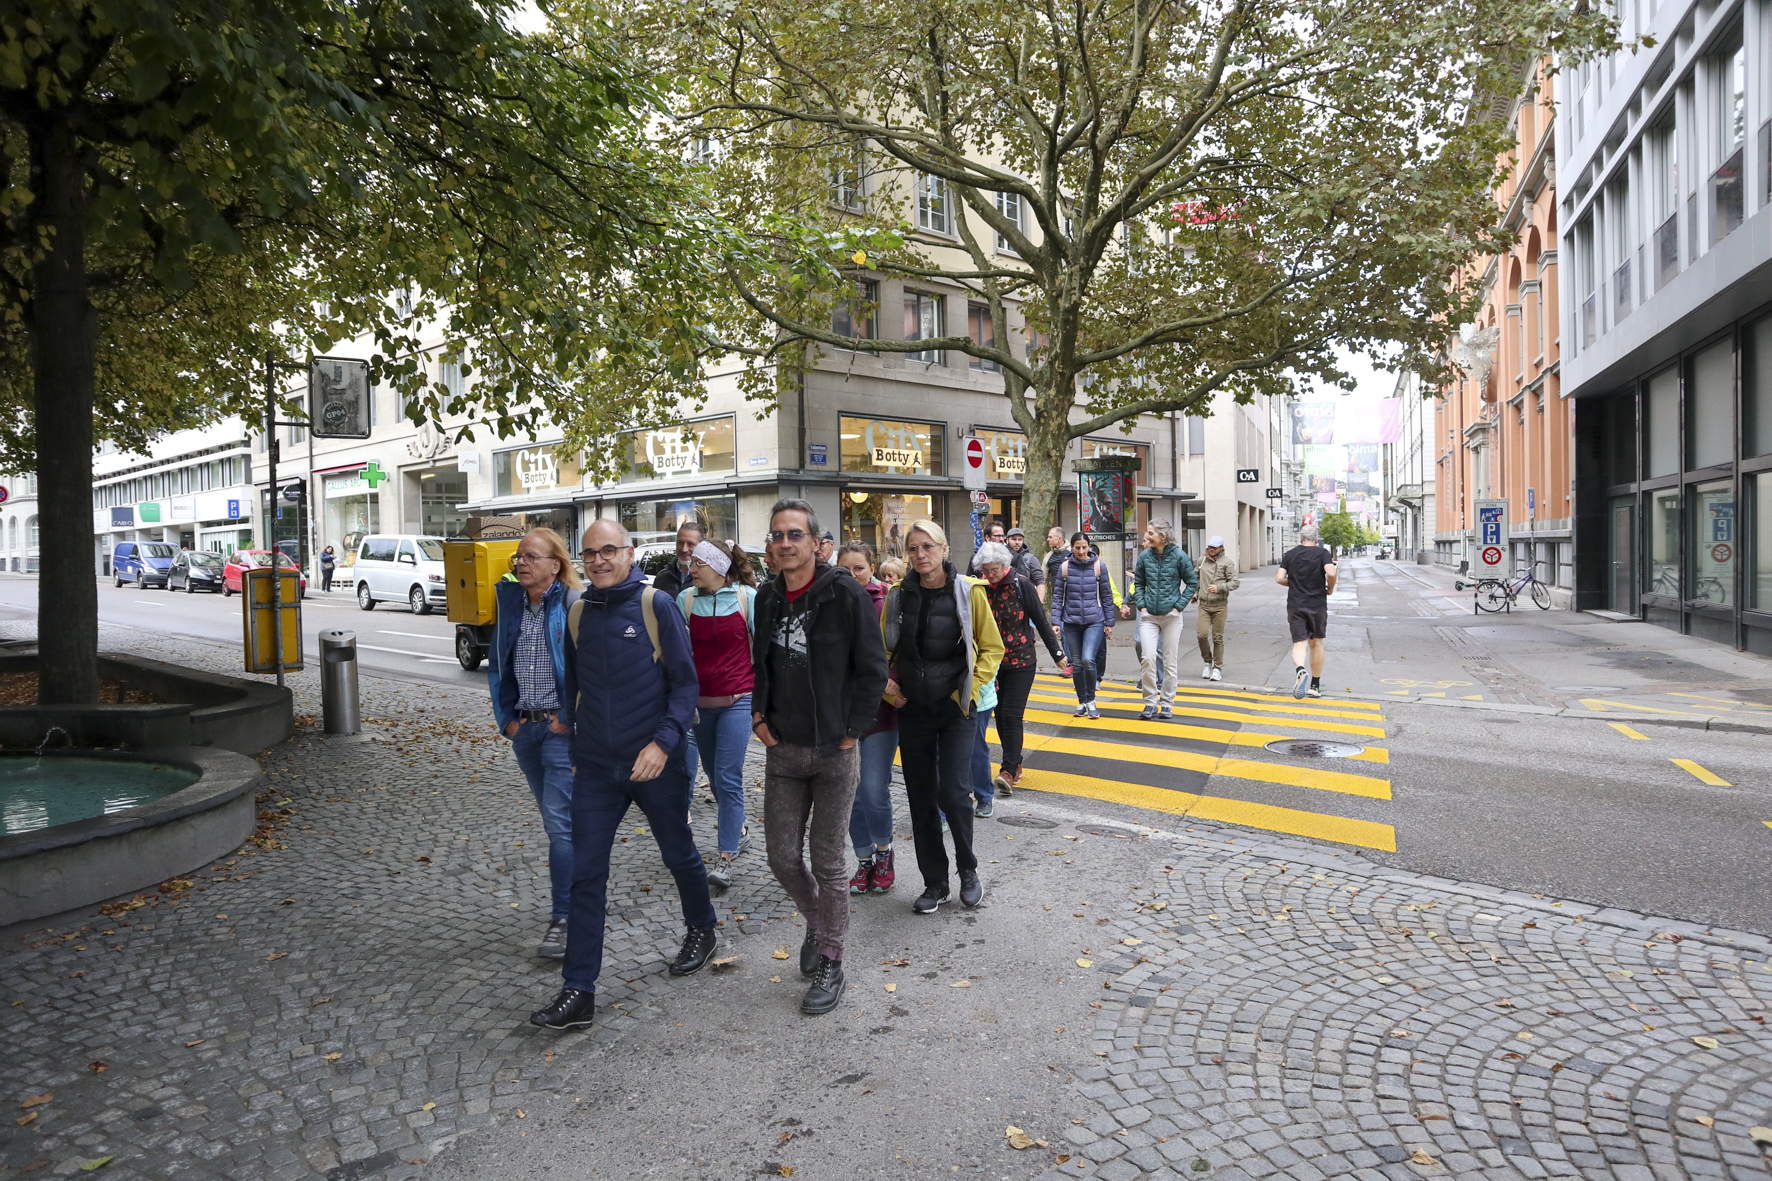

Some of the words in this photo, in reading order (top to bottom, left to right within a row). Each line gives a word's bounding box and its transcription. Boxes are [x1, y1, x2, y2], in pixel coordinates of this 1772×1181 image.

[326, 409, 346, 419] GP04
[1294, 405, 1334, 417] olma
[1348, 444, 1378, 454] olma
[657, 455, 687, 468] Botty
[876, 449, 909, 465] Botty
[990, 432, 1028, 480] Cit
[998, 457, 1026, 472] Botty
[524, 473, 547, 484] Botty
[1239, 471, 1256, 481] C&A
[328, 481, 348, 491] GALLUS
[1112, 472, 1122, 522] HOLLOW
[230, 501, 237, 510] P
[1083, 494, 1091, 532] SLEEPY
[482, 530, 521, 538] zalando
[1487, 523, 1496, 536] P
